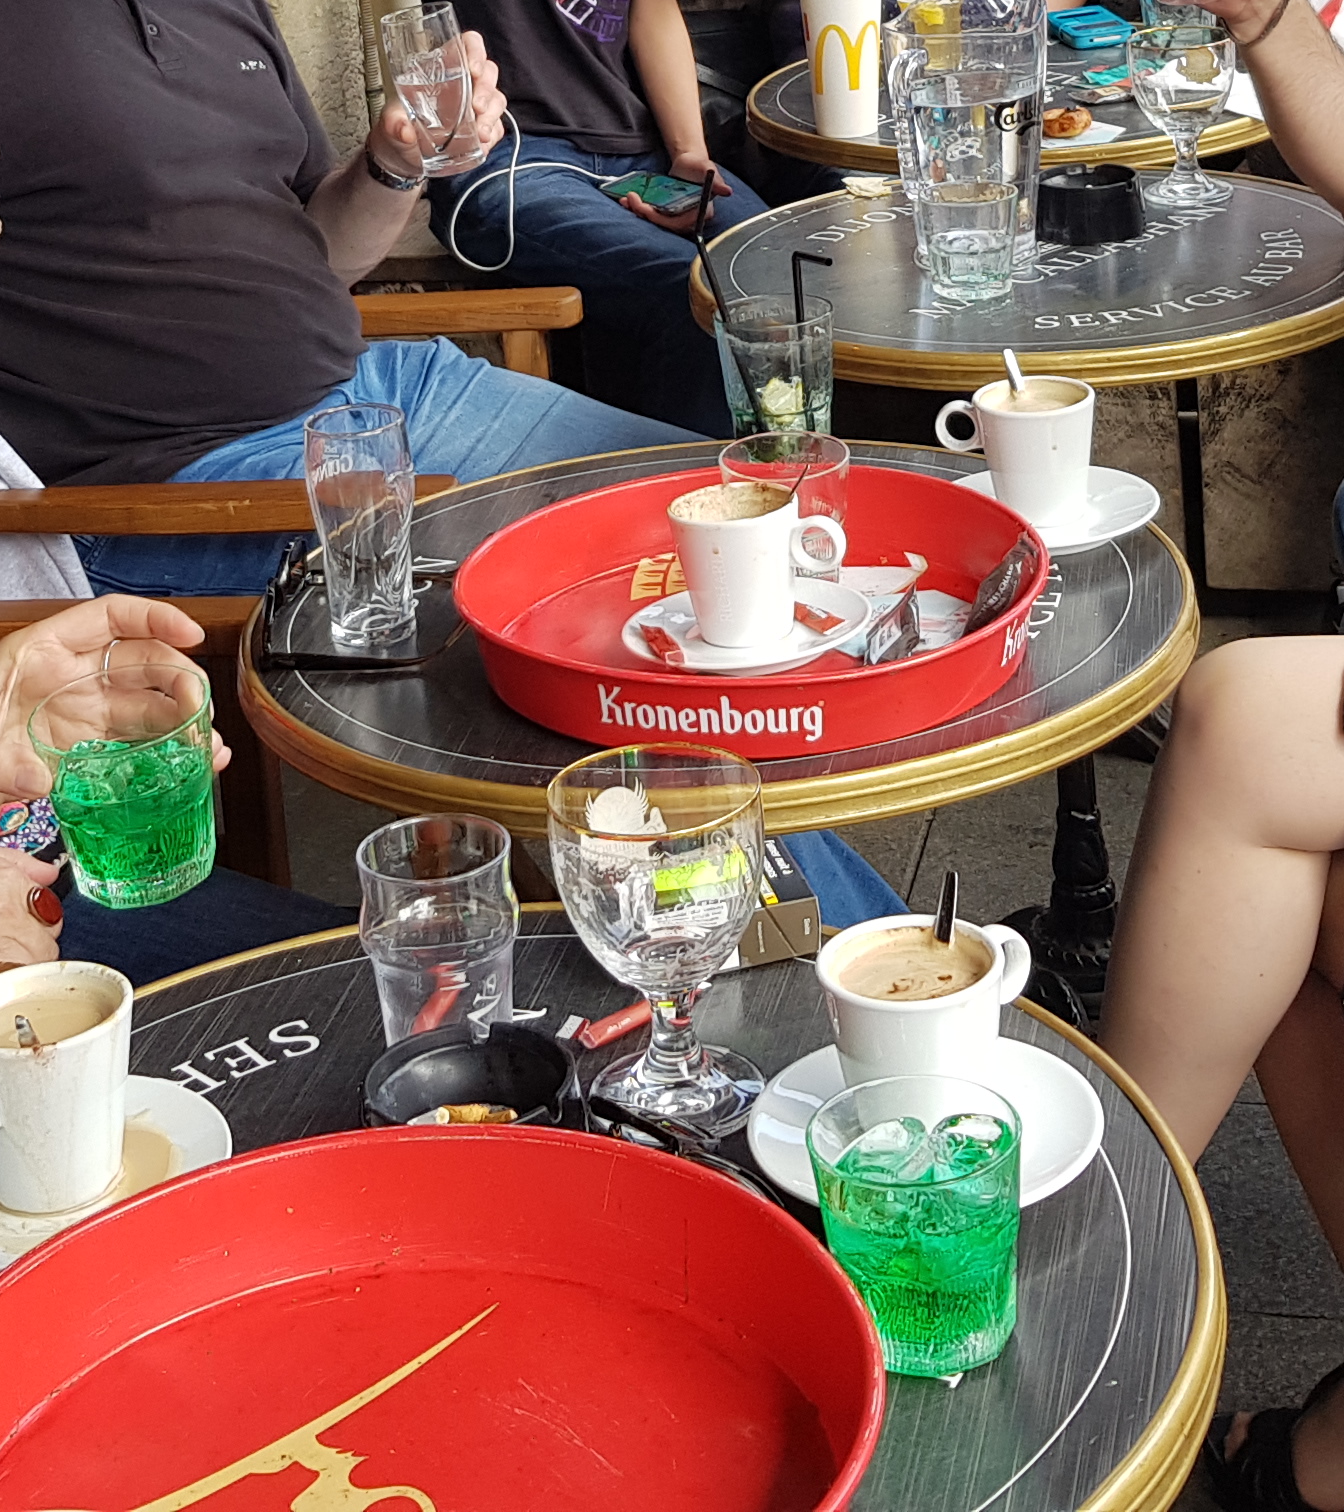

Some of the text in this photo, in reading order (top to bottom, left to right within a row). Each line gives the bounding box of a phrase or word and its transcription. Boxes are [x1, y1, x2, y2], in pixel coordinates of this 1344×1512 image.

[1034, 228, 1304, 329] SERVICE AU BAR
[597, 683, 824, 742] Kronenbourg
